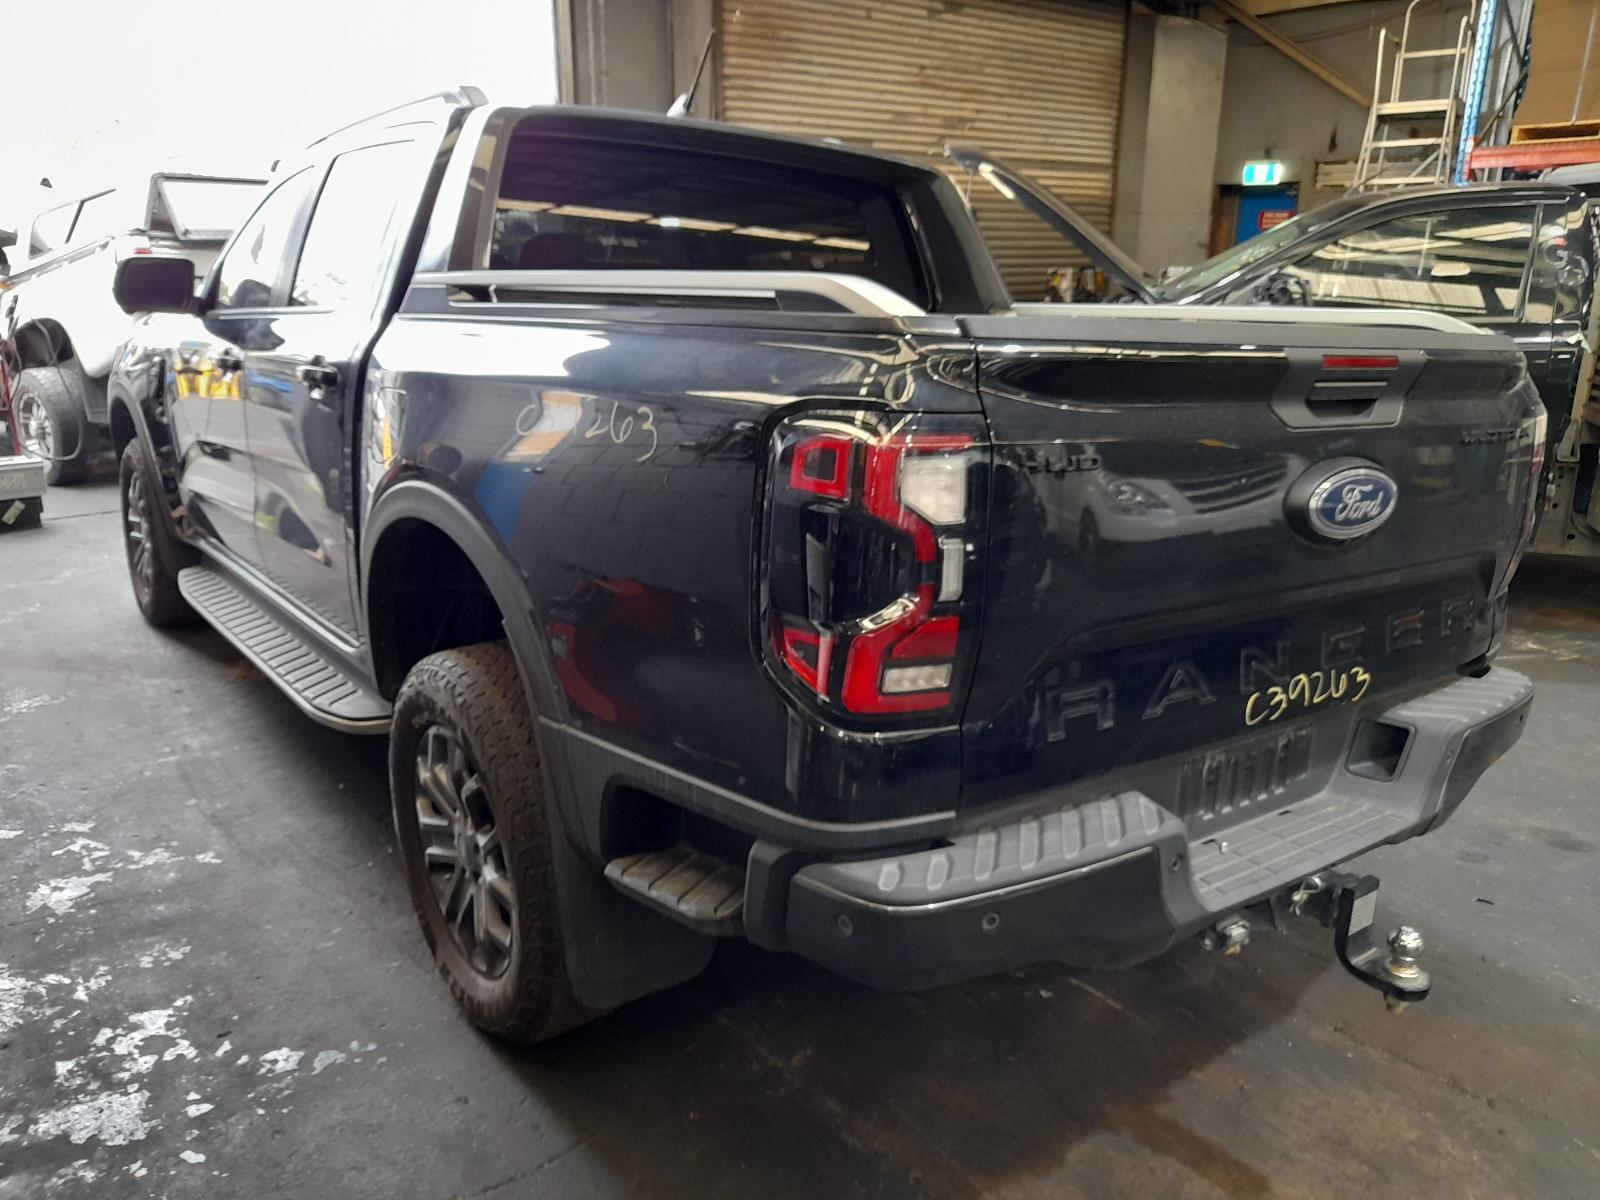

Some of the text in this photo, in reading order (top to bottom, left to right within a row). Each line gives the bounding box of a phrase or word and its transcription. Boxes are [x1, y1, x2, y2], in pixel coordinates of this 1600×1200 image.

[1335, 484, 1383, 522] Ford
[1045, 597, 1473, 742] RANGER
[1245, 666, 1372, 726] C39263
